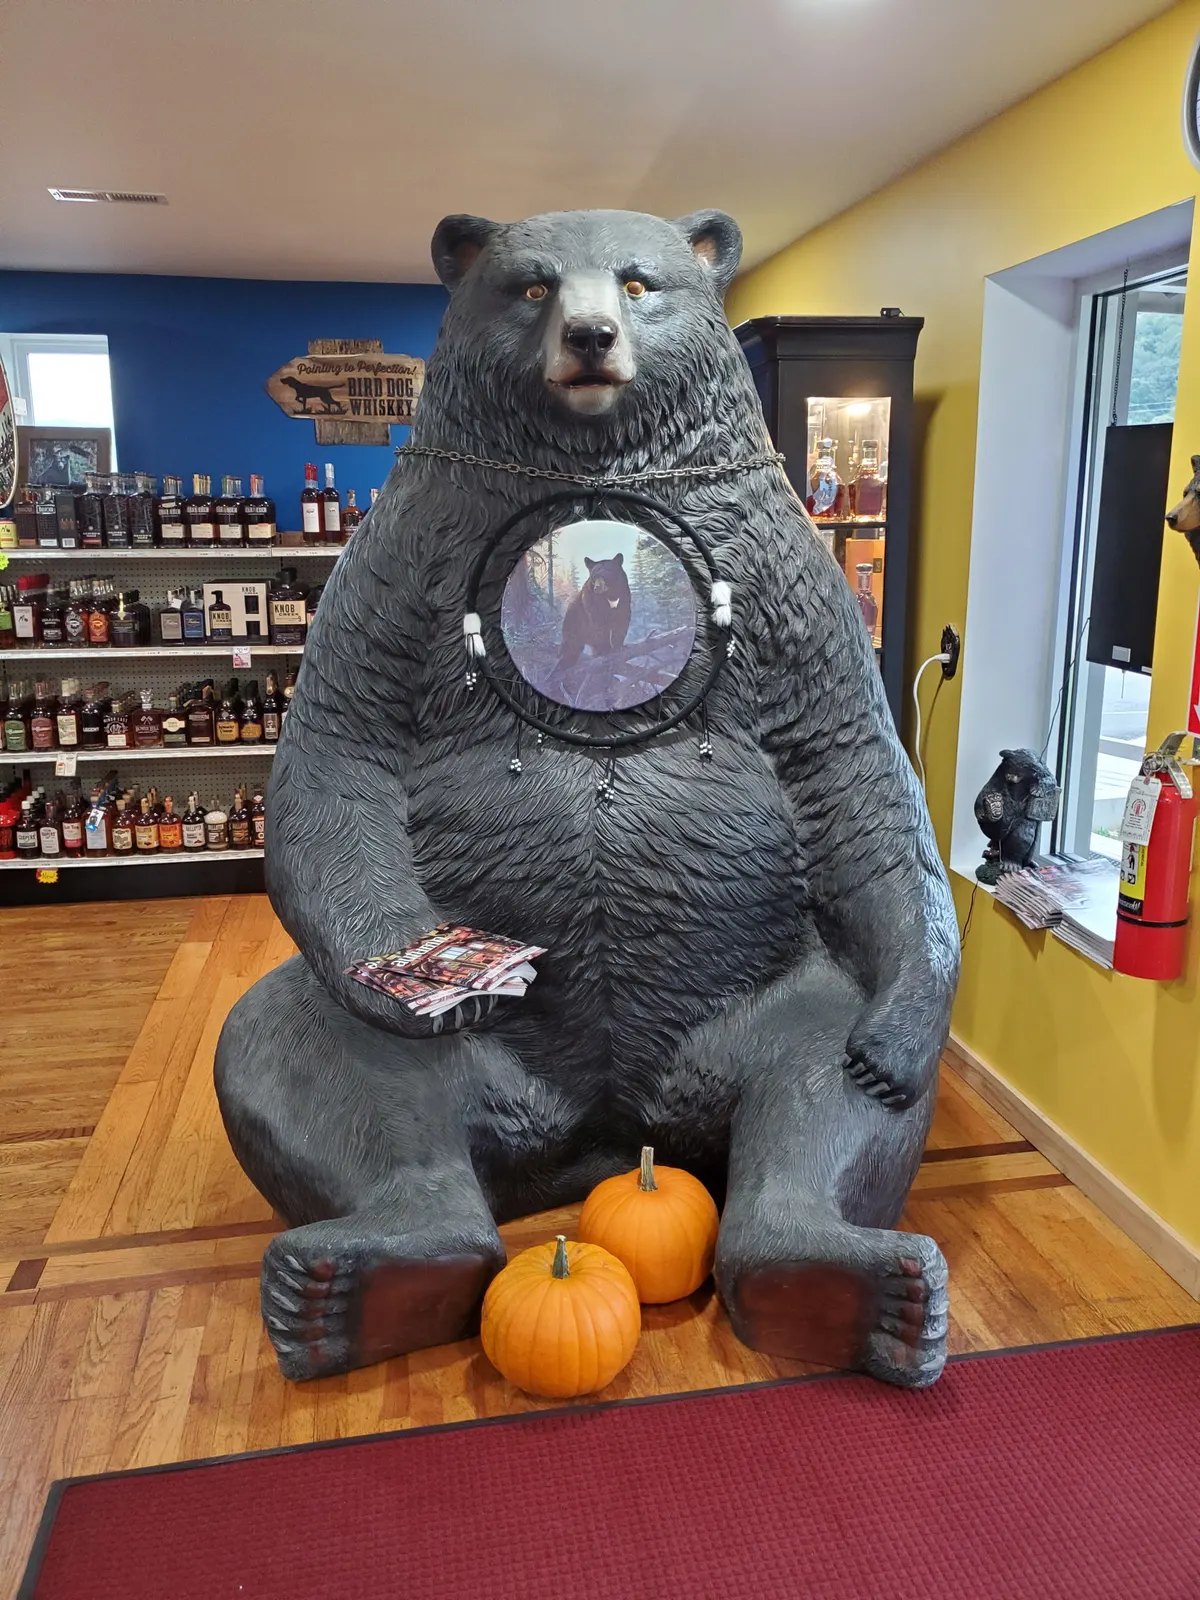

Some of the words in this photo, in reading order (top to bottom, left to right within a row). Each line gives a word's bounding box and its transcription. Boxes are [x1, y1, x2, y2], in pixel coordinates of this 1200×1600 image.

[297, 362, 343, 376] Pointing
[344, 364, 355, 373] to
[357, 360, 417, 376] Perfection!
[348, 377, 383, 397] BIRD
[387, 378, 414, 397] DOG
[350, 398, 413, 417] WHISKEY
[274, 603, 295, 612] KNOB
[391, 936, 450, 967] autumn
